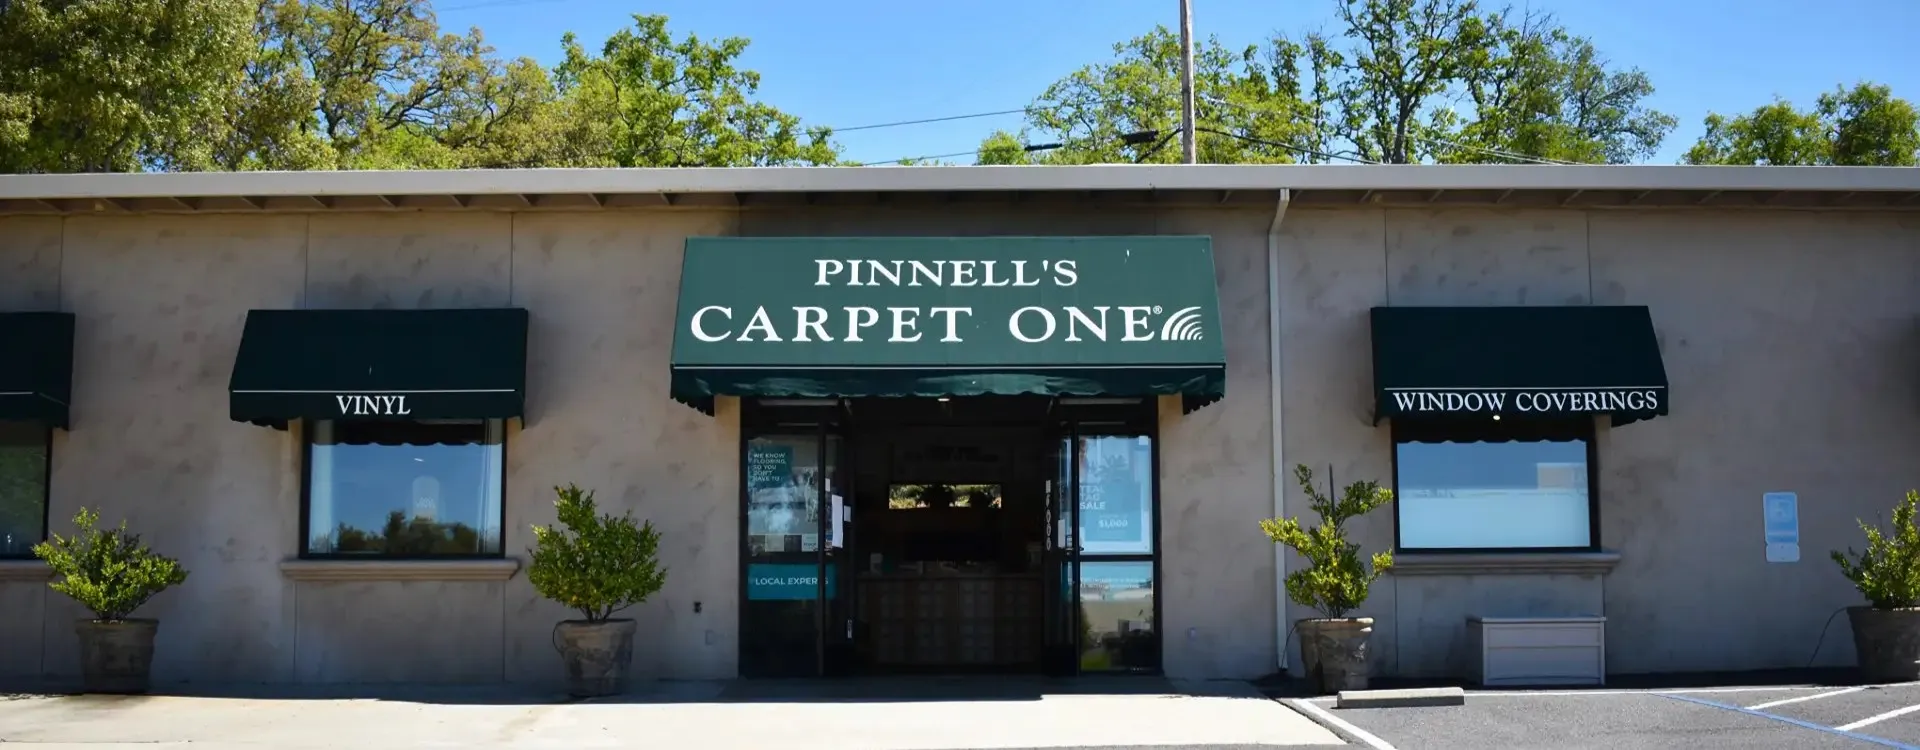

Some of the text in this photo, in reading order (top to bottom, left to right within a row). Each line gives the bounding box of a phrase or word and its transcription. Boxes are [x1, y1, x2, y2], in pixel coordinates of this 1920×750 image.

[814, 259, 1078, 287] PINNELL'S
[690, 305, 973, 343] CARPET
[336, 395, 411, 415] VINYL
[1393, 390, 1658, 412] WINDOW COVERINGS
[1080, 501, 1106, 510] SALE
[755, 577, 829, 586] LOCAL EXPERS
